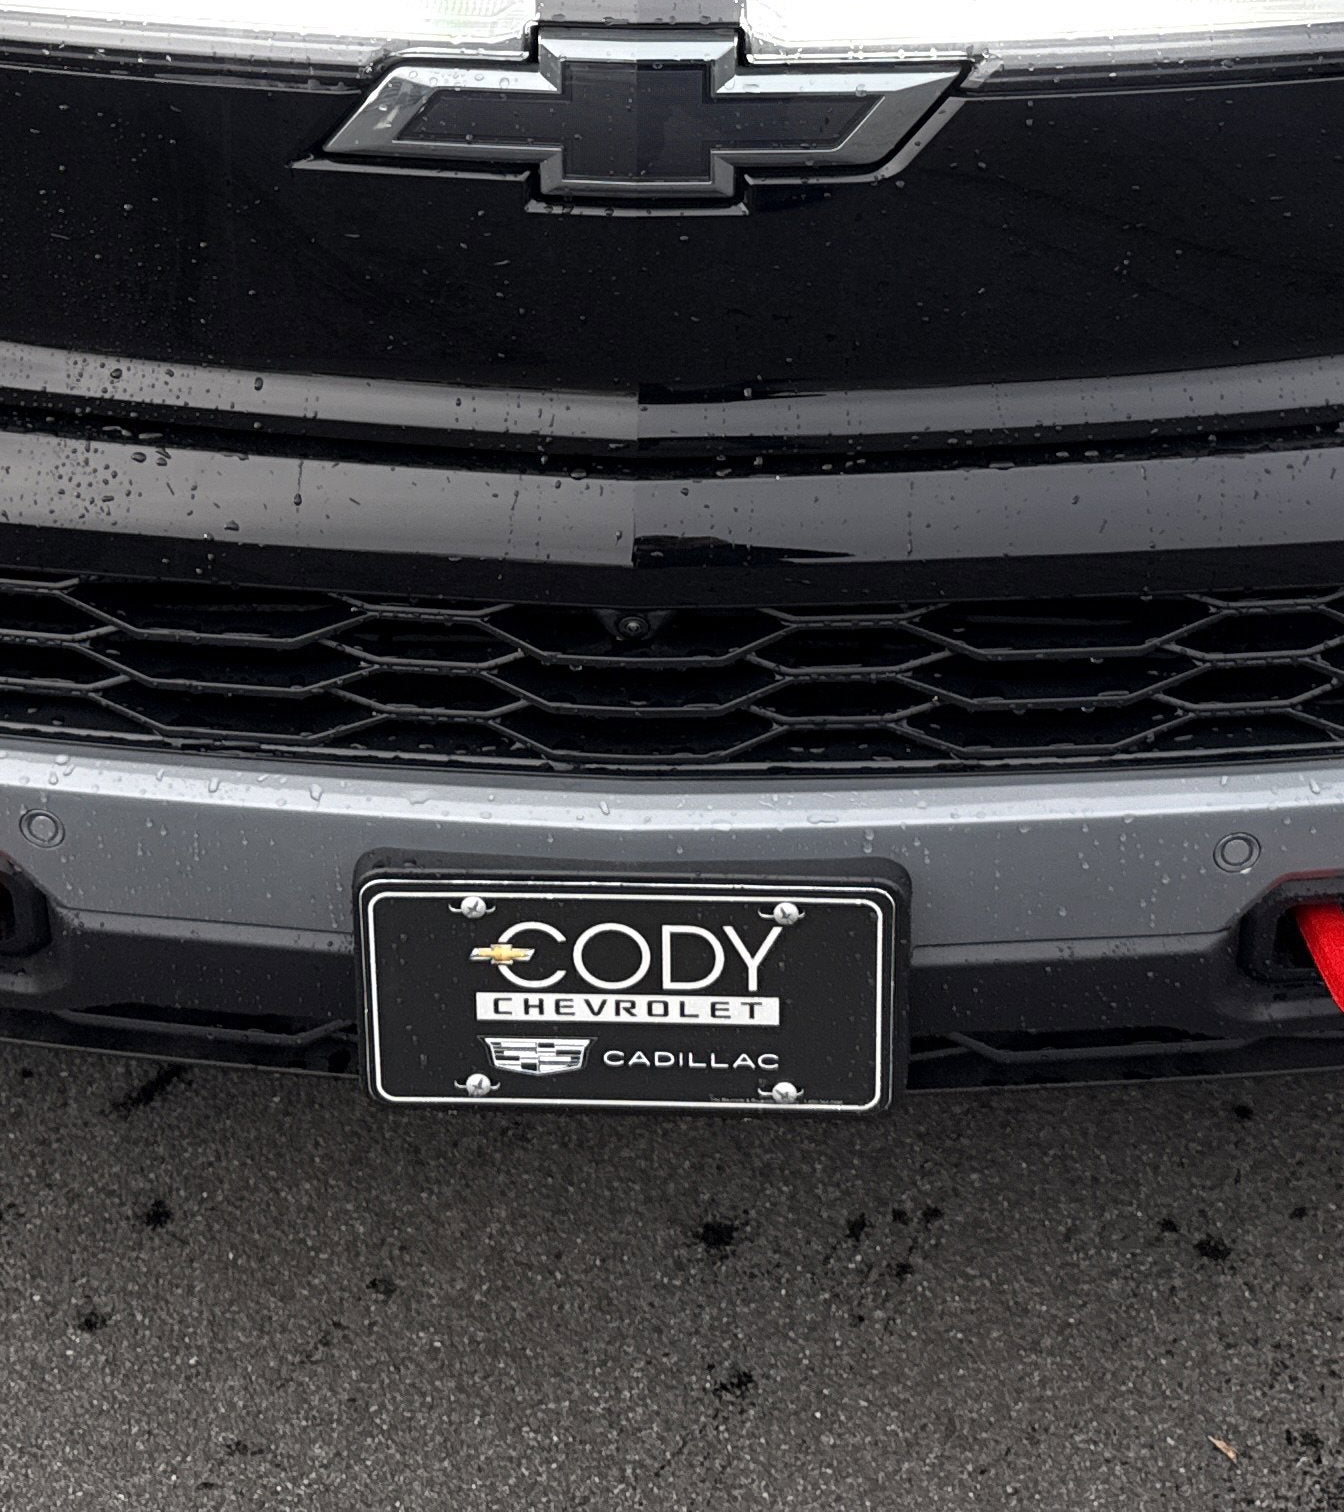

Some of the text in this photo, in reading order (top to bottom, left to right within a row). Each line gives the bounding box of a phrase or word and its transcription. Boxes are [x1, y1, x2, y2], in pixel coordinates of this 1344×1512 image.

[496, 921, 783, 992] CODY
[492, 996, 764, 1021] CHEVROLET
[602, 1049, 780, 1070] CADILLAC
